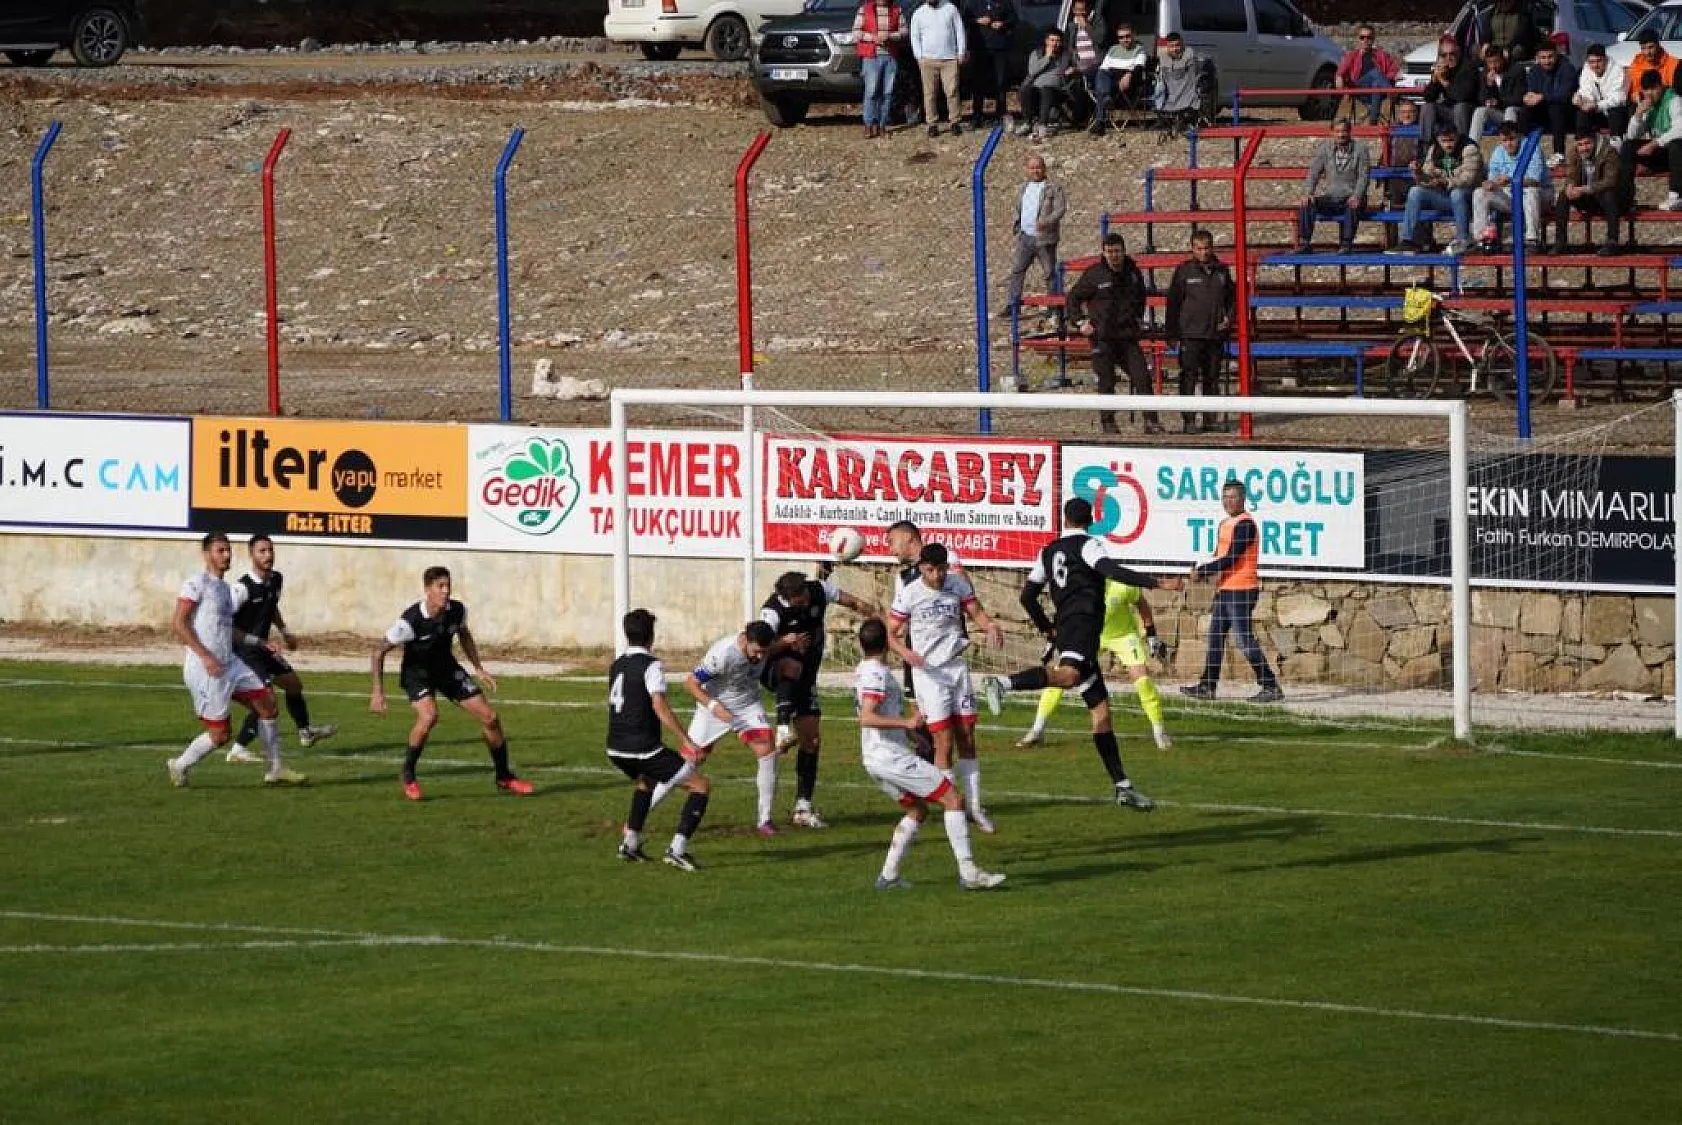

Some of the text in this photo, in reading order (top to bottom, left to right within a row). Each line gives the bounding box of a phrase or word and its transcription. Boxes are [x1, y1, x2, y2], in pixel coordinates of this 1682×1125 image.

[98, 458, 179, 491] CAM
[220, 430, 326, 490] ilter
[384, 467, 443, 490] market
[589, 440, 742, 498] KEMER
[776, 447, 1046, 506] KARACABEY
[482, 476, 566, 508] Gedik
[287, 512, 324, 533] Aziz
[589, 506, 741, 543] TAUKÇULUK
[1003, 515, 1014, 526] ve
[1016, 511, 1046, 529] Kasap
[1187, 518, 1325, 557] TiRET
[1477, 527, 1514, 545] Fatih
[1519, 530, 1572, 547] Furkan
[1052, 550, 1068, 588] 6
[609, 672, 624, 713] 4
